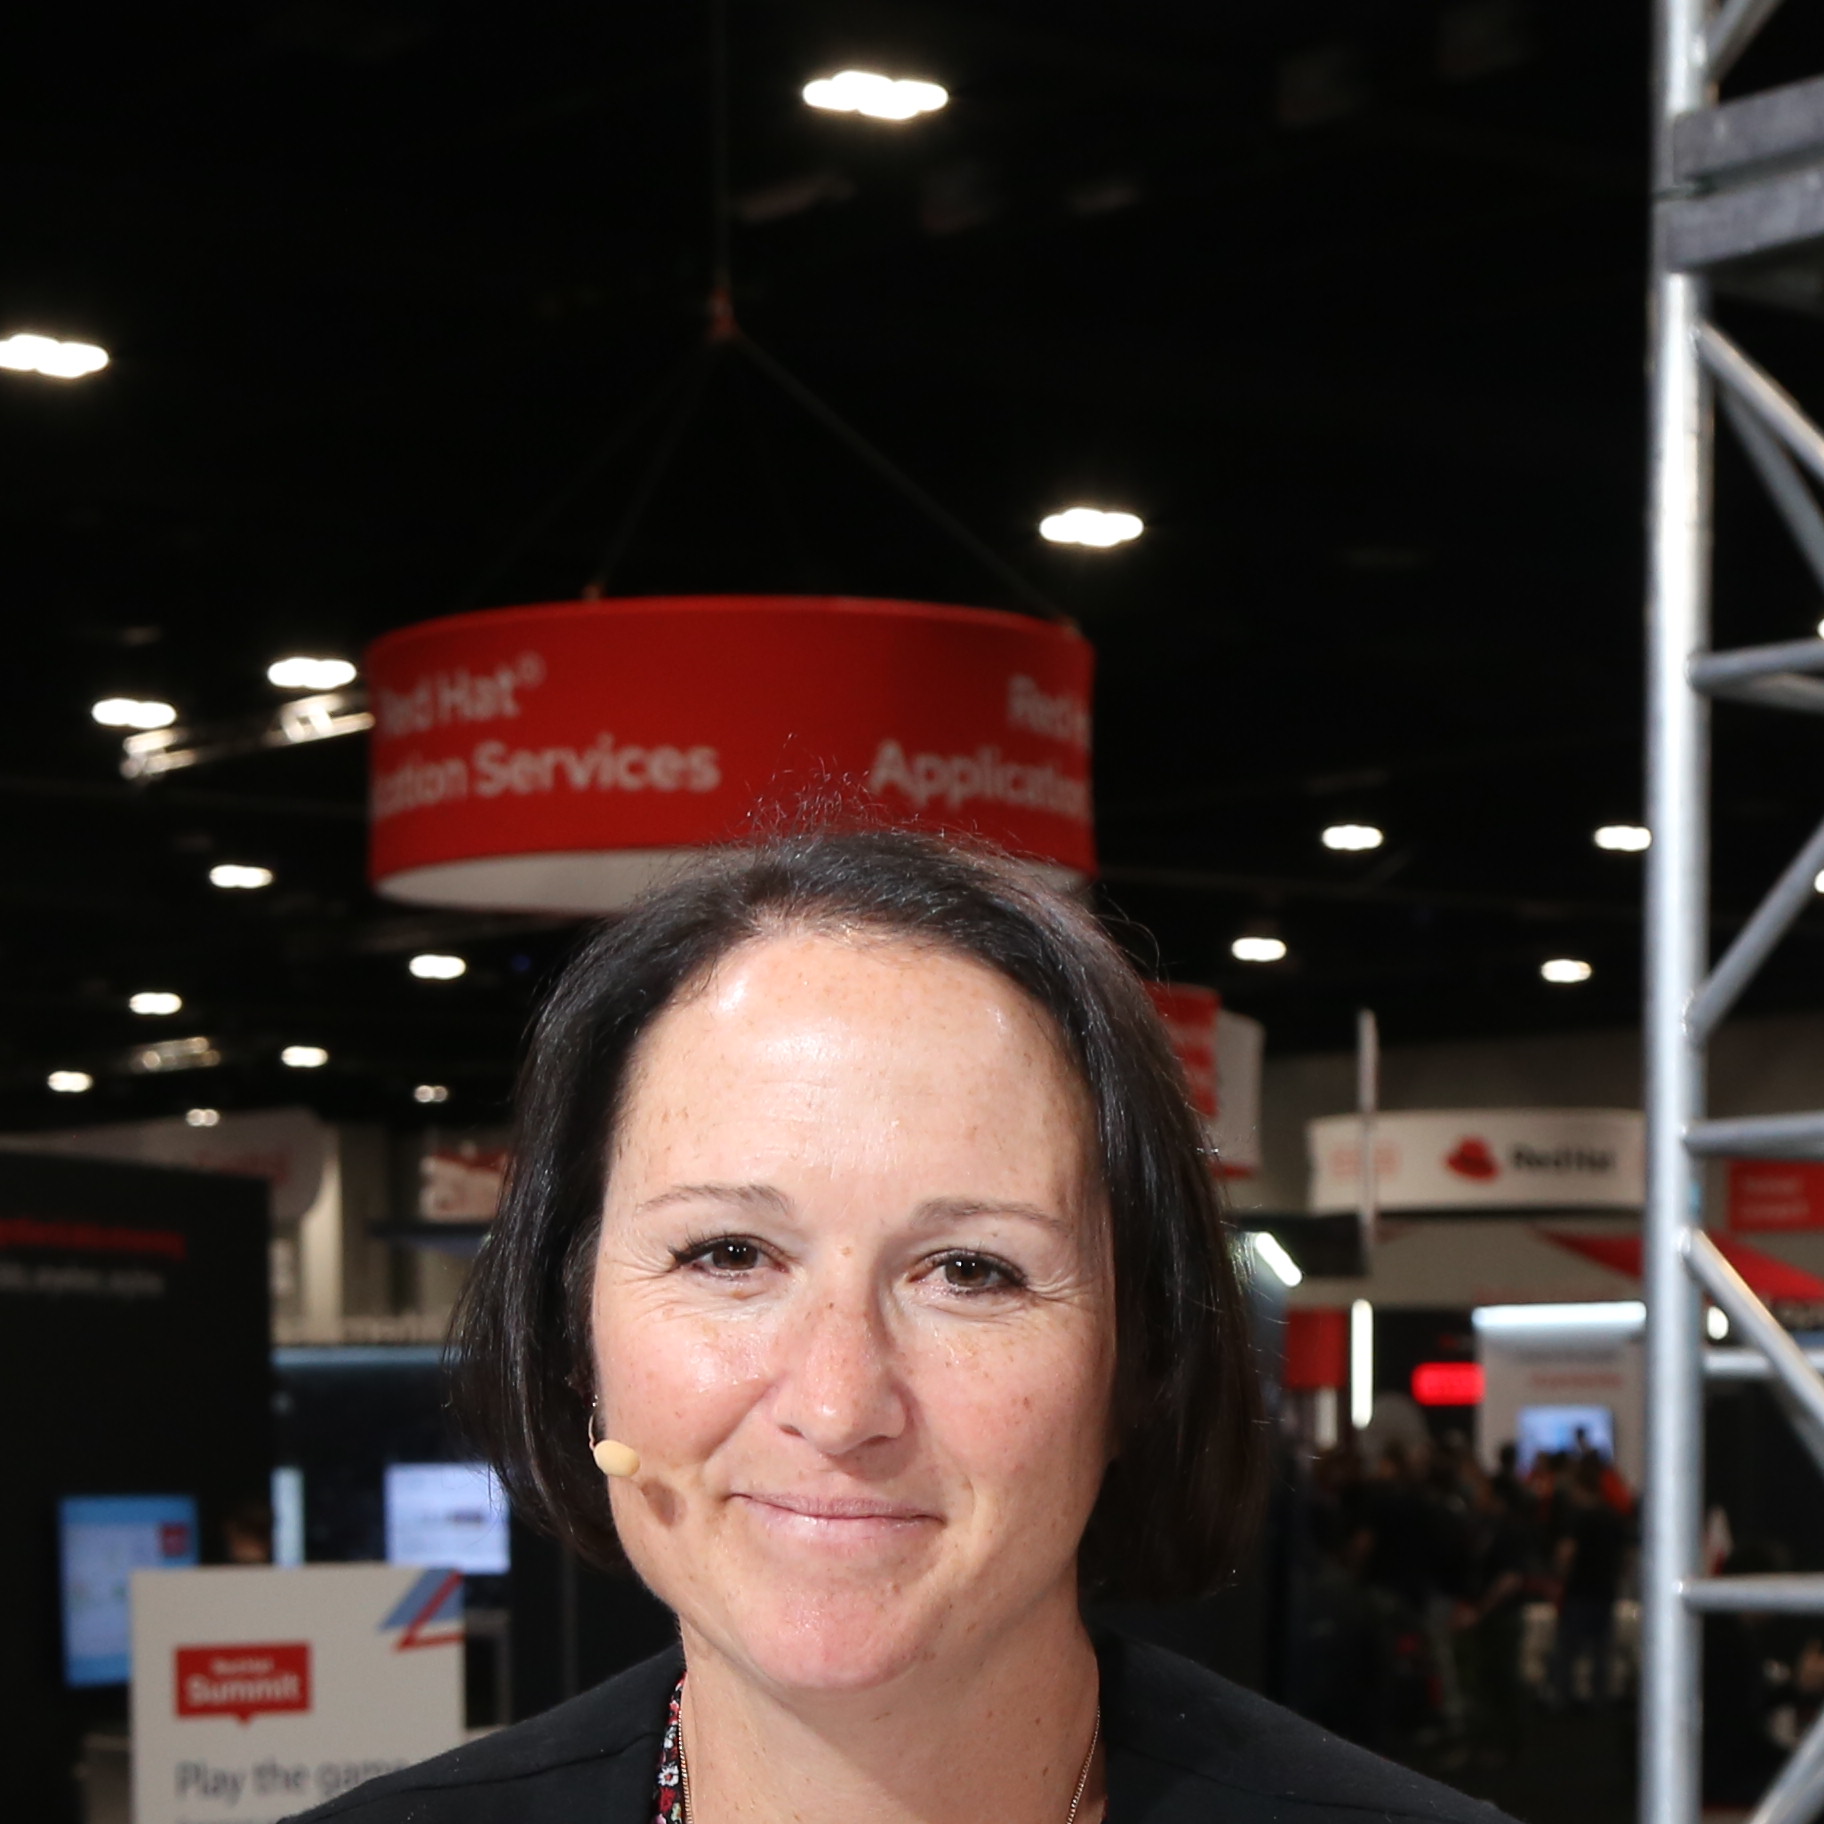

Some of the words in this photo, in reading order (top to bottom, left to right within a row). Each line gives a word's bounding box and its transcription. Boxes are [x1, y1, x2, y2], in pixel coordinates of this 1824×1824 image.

[473, 735, 722, 797] Services
[186, 1673, 300, 1706] Summit
[176, 1758, 246, 1807] Play
[251, 1755, 309, 1796] the
